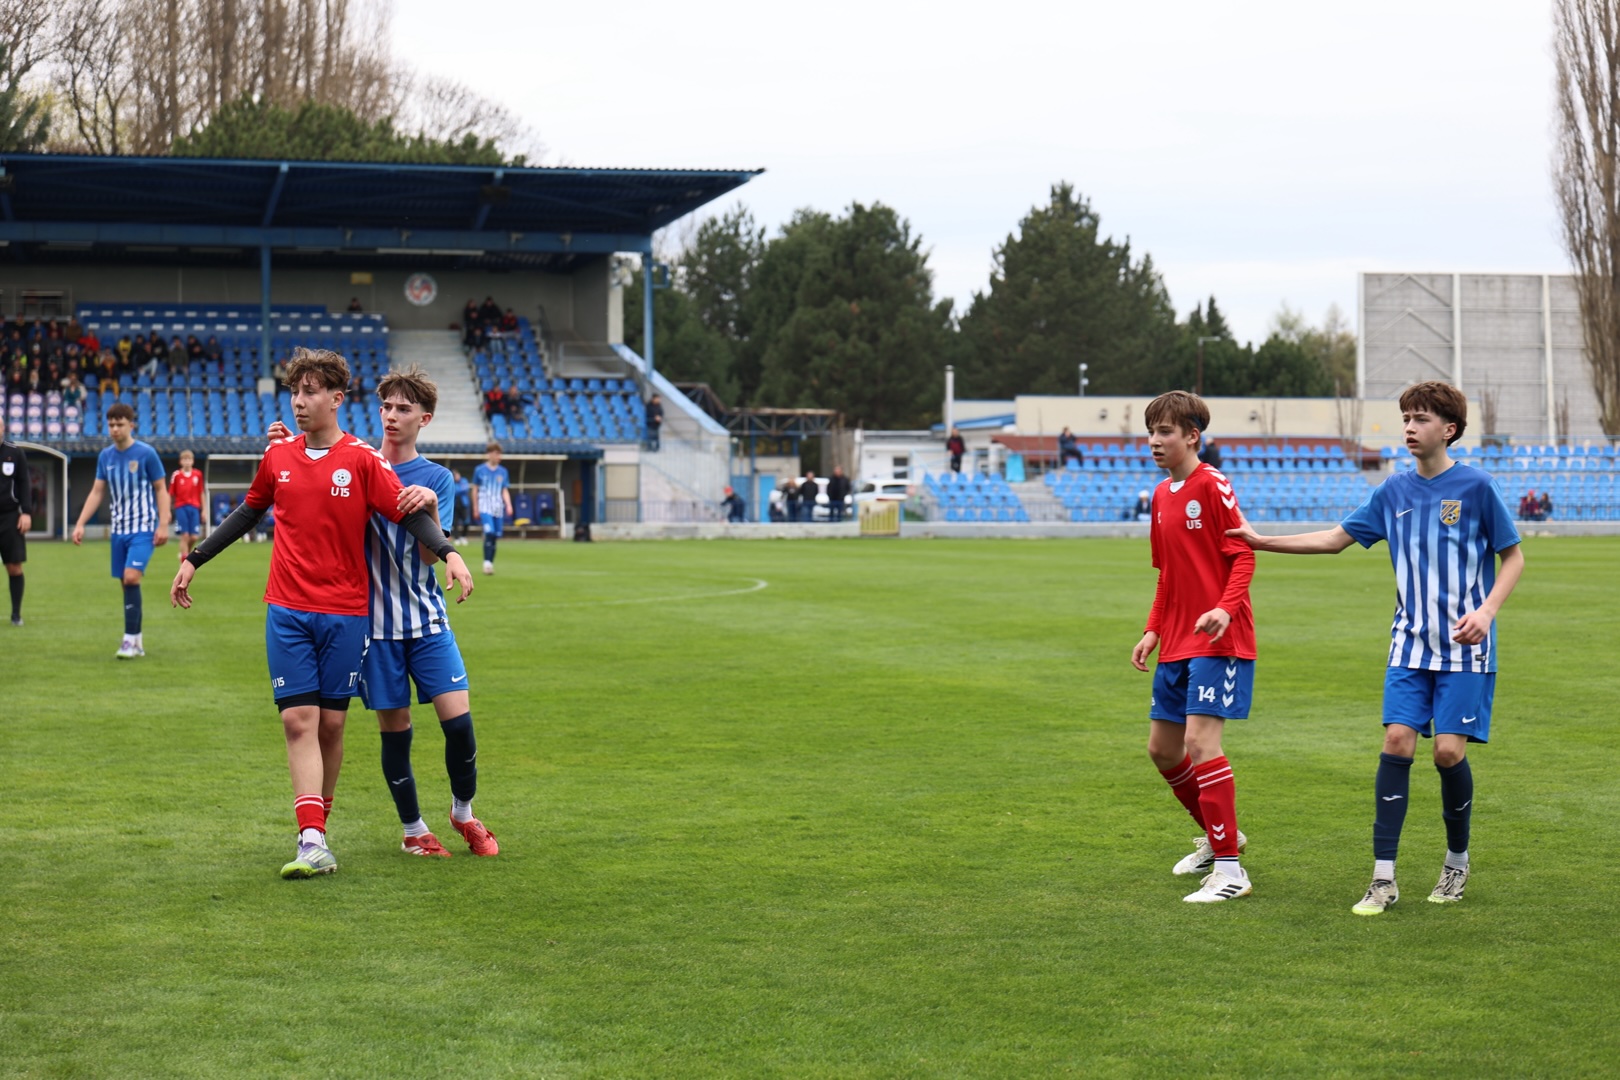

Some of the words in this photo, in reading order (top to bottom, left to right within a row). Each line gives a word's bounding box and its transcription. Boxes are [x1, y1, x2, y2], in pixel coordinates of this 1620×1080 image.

[330, 486, 350, 498] U15
[1186, 519, 1203, 530] U15
[272, 676, 285, 688] U15
[1197, 685, 1216, 703] 14
